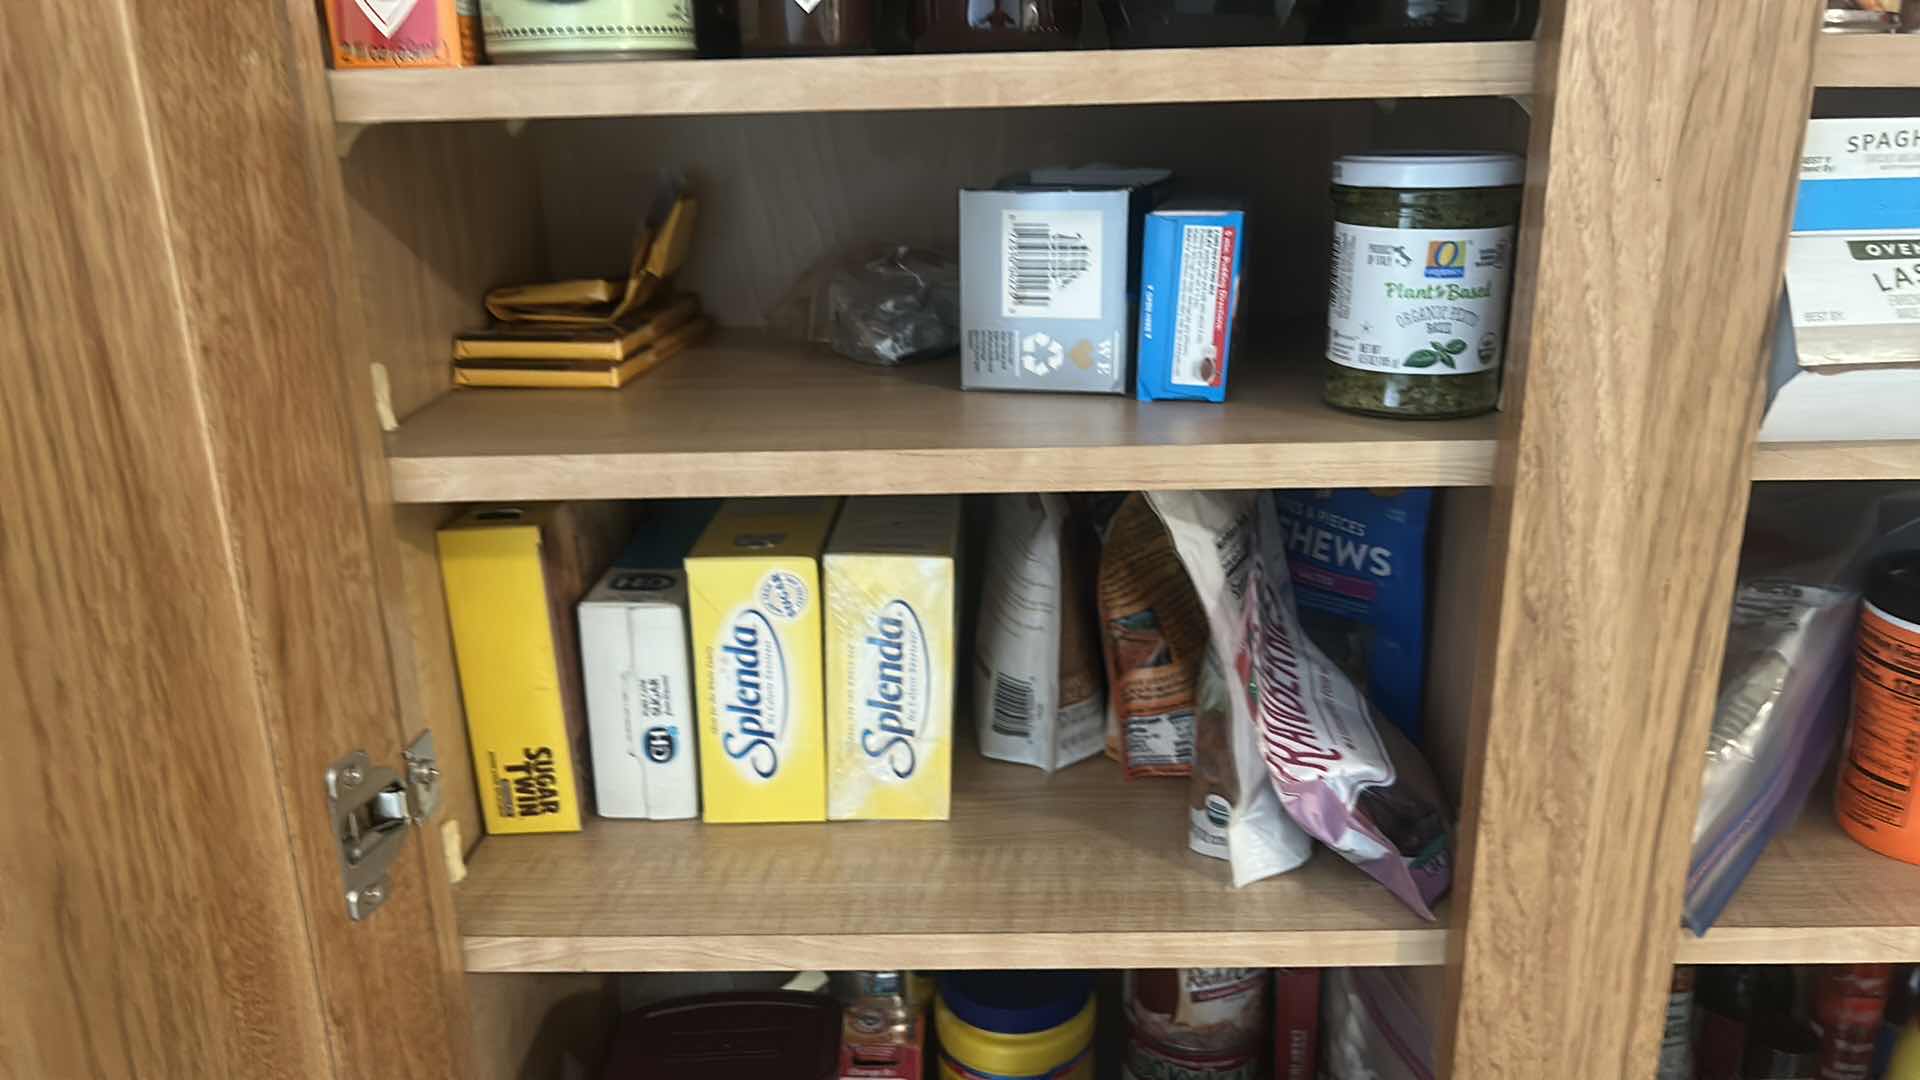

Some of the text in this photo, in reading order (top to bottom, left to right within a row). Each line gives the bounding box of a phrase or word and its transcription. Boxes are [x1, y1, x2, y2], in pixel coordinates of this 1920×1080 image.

[1384, 280, 1492, 302] Plant Based
[1281, 514, 1393, 577] HEWS
[720, 622, 778, 780] Splenda
[860, 616, 917, 780] Splenda
[504, 760, 541, 818] TWIN
[523, 745, 560, 815] SUGAR
